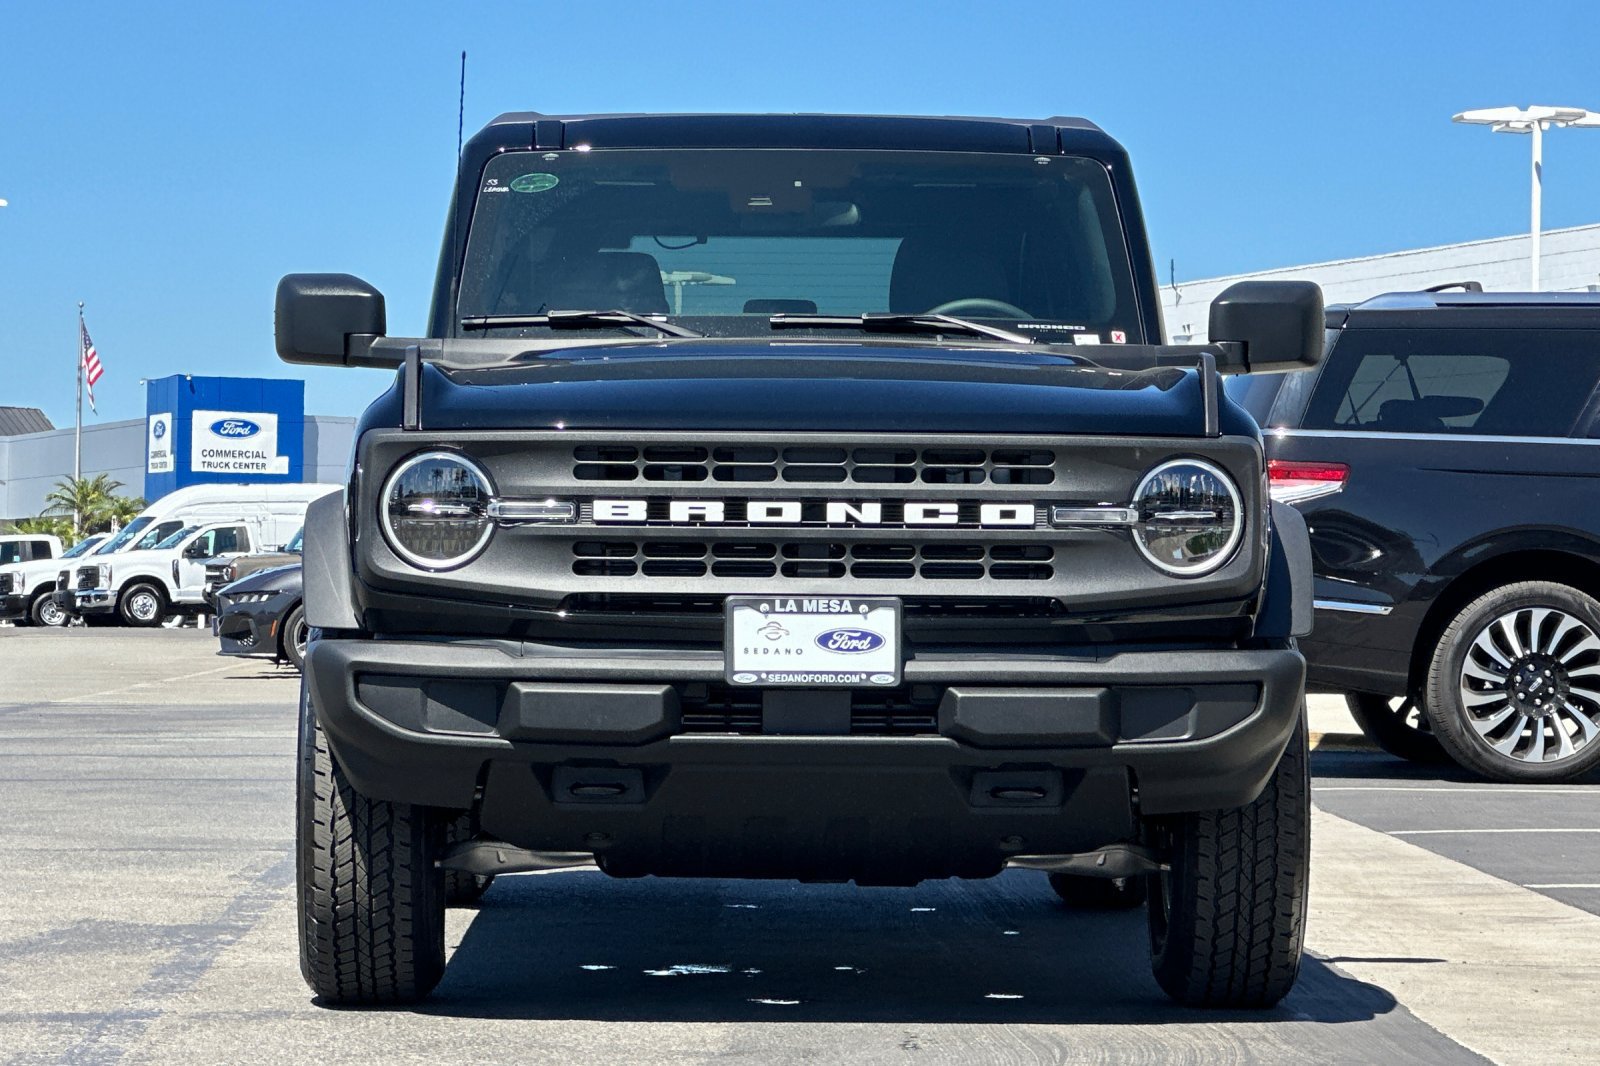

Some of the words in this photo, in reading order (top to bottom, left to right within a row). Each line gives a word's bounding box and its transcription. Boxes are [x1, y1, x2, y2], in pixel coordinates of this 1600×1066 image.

[219, 420, 251, 436] Ford
[201, 449, 267, 459] COMMERCIAL
[202, 461, 230, 470] TRUCK
[232, 461, 267, 470] CENTER
[592, 499, 1035, 525] BRONCO
[774, 599, 798, 613] LA
[802, 599, 853, 613] MESA
[828, 630, 872, 650] Ford
[743, 647, 804, 656] SEDANO
[768, 674, 860, 683] SEDANOFORD.COM
